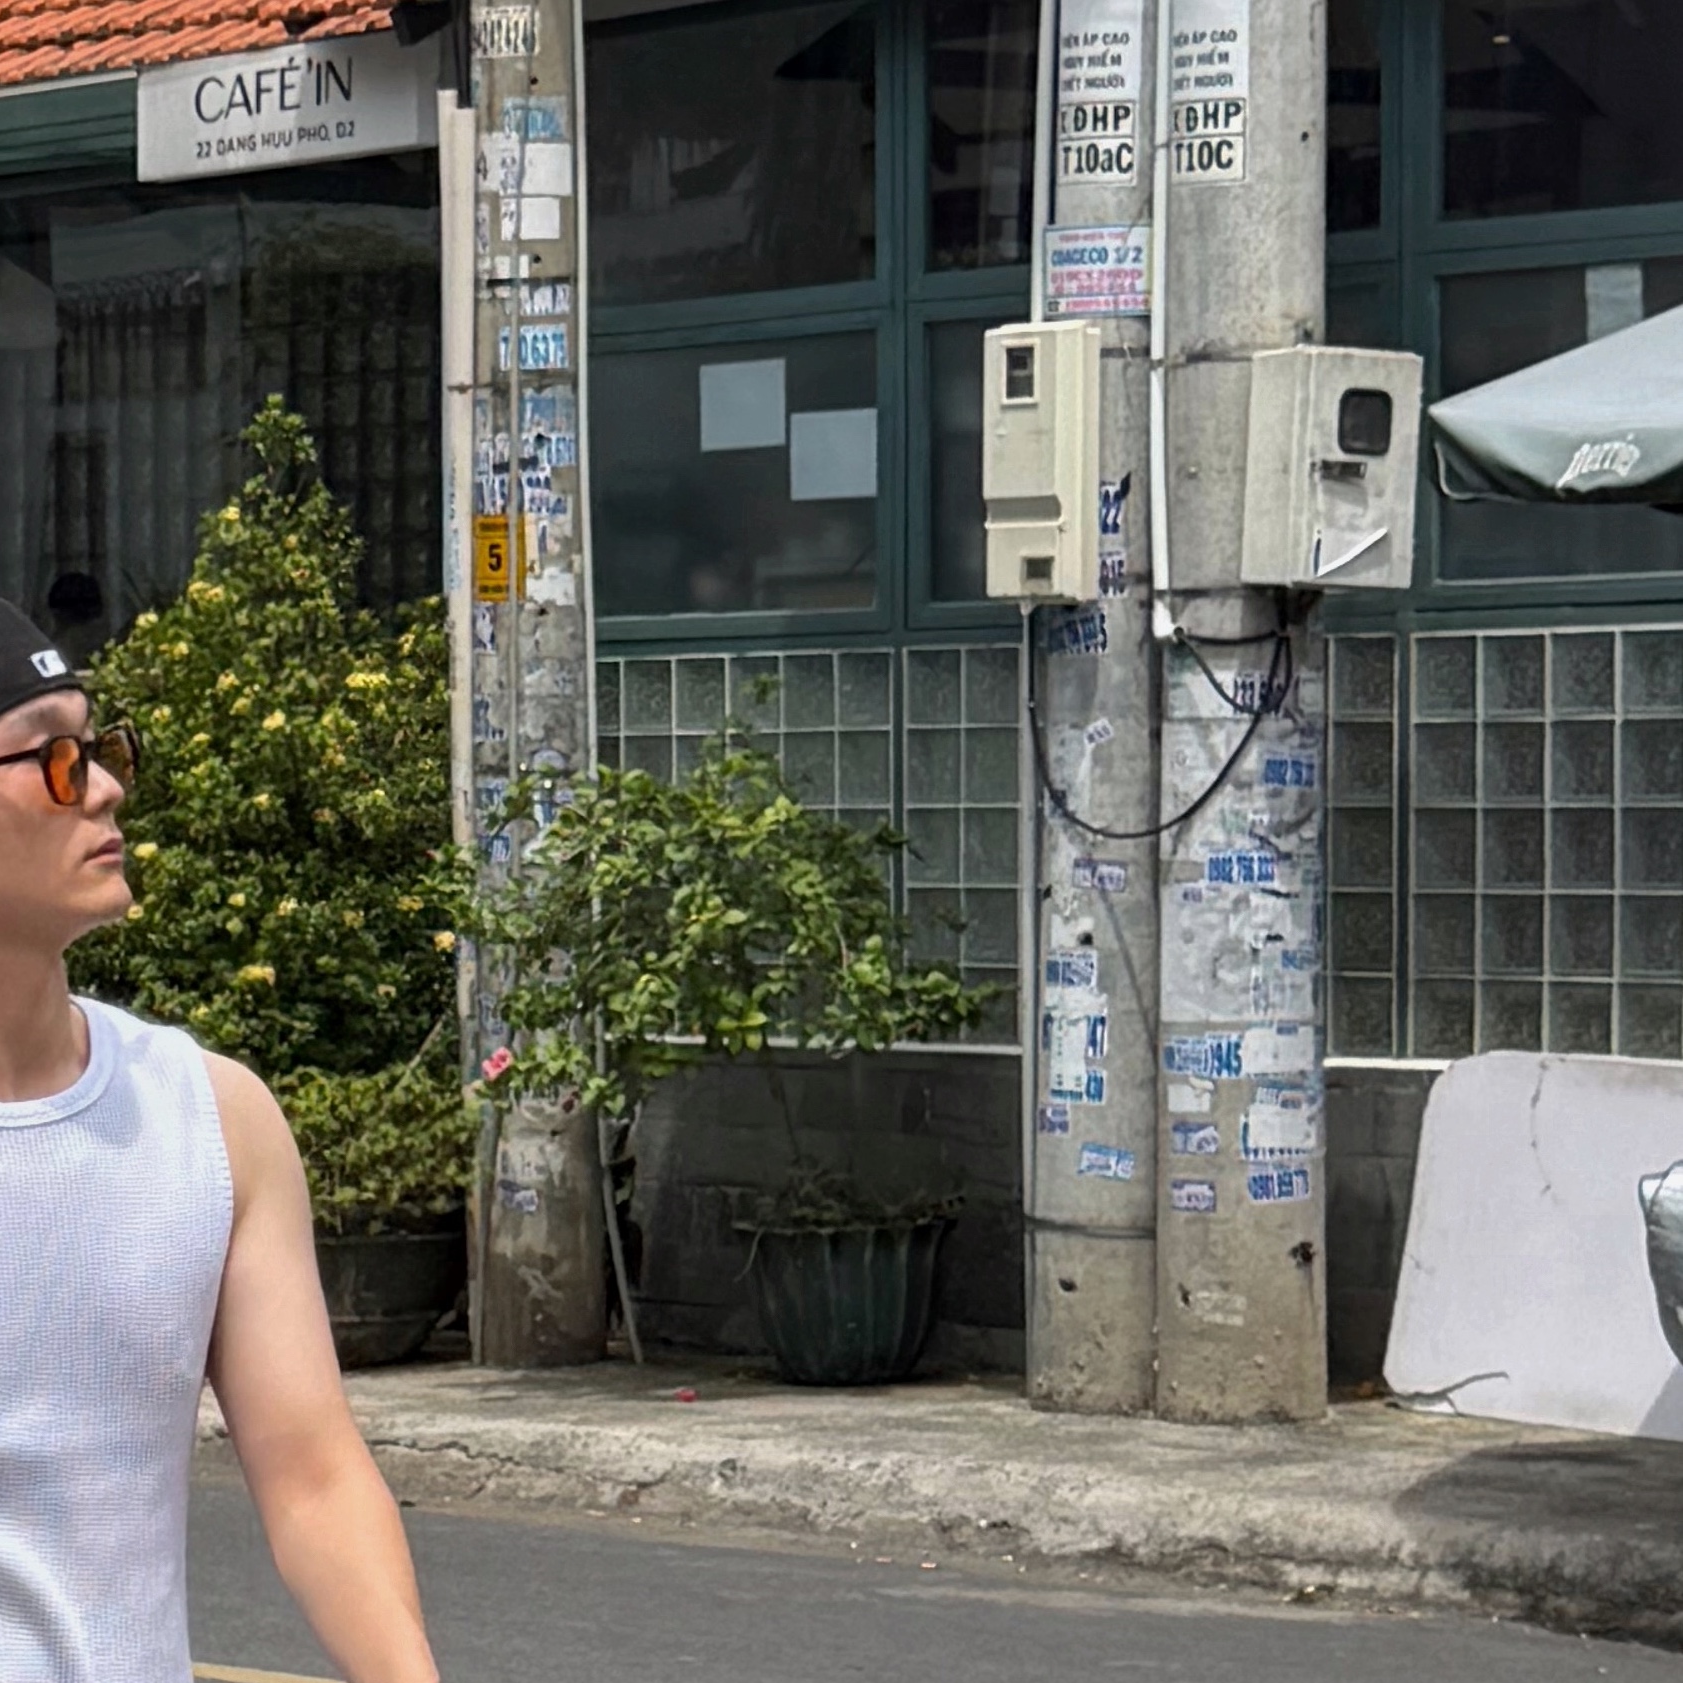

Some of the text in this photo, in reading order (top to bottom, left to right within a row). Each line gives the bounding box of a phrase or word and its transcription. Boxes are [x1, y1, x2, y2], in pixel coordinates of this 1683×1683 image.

[1102, 31, 1130, 47] CAO
[1210, 28, 1237, 44] CAO
[196, 141, 212, 159] 22
[261, 130, 293, 149] HUU
[1063, 142, 1134, 175] T10aC
[1175, 139, 1234, 174] T10C
[488, 543, 503, 572] 5
